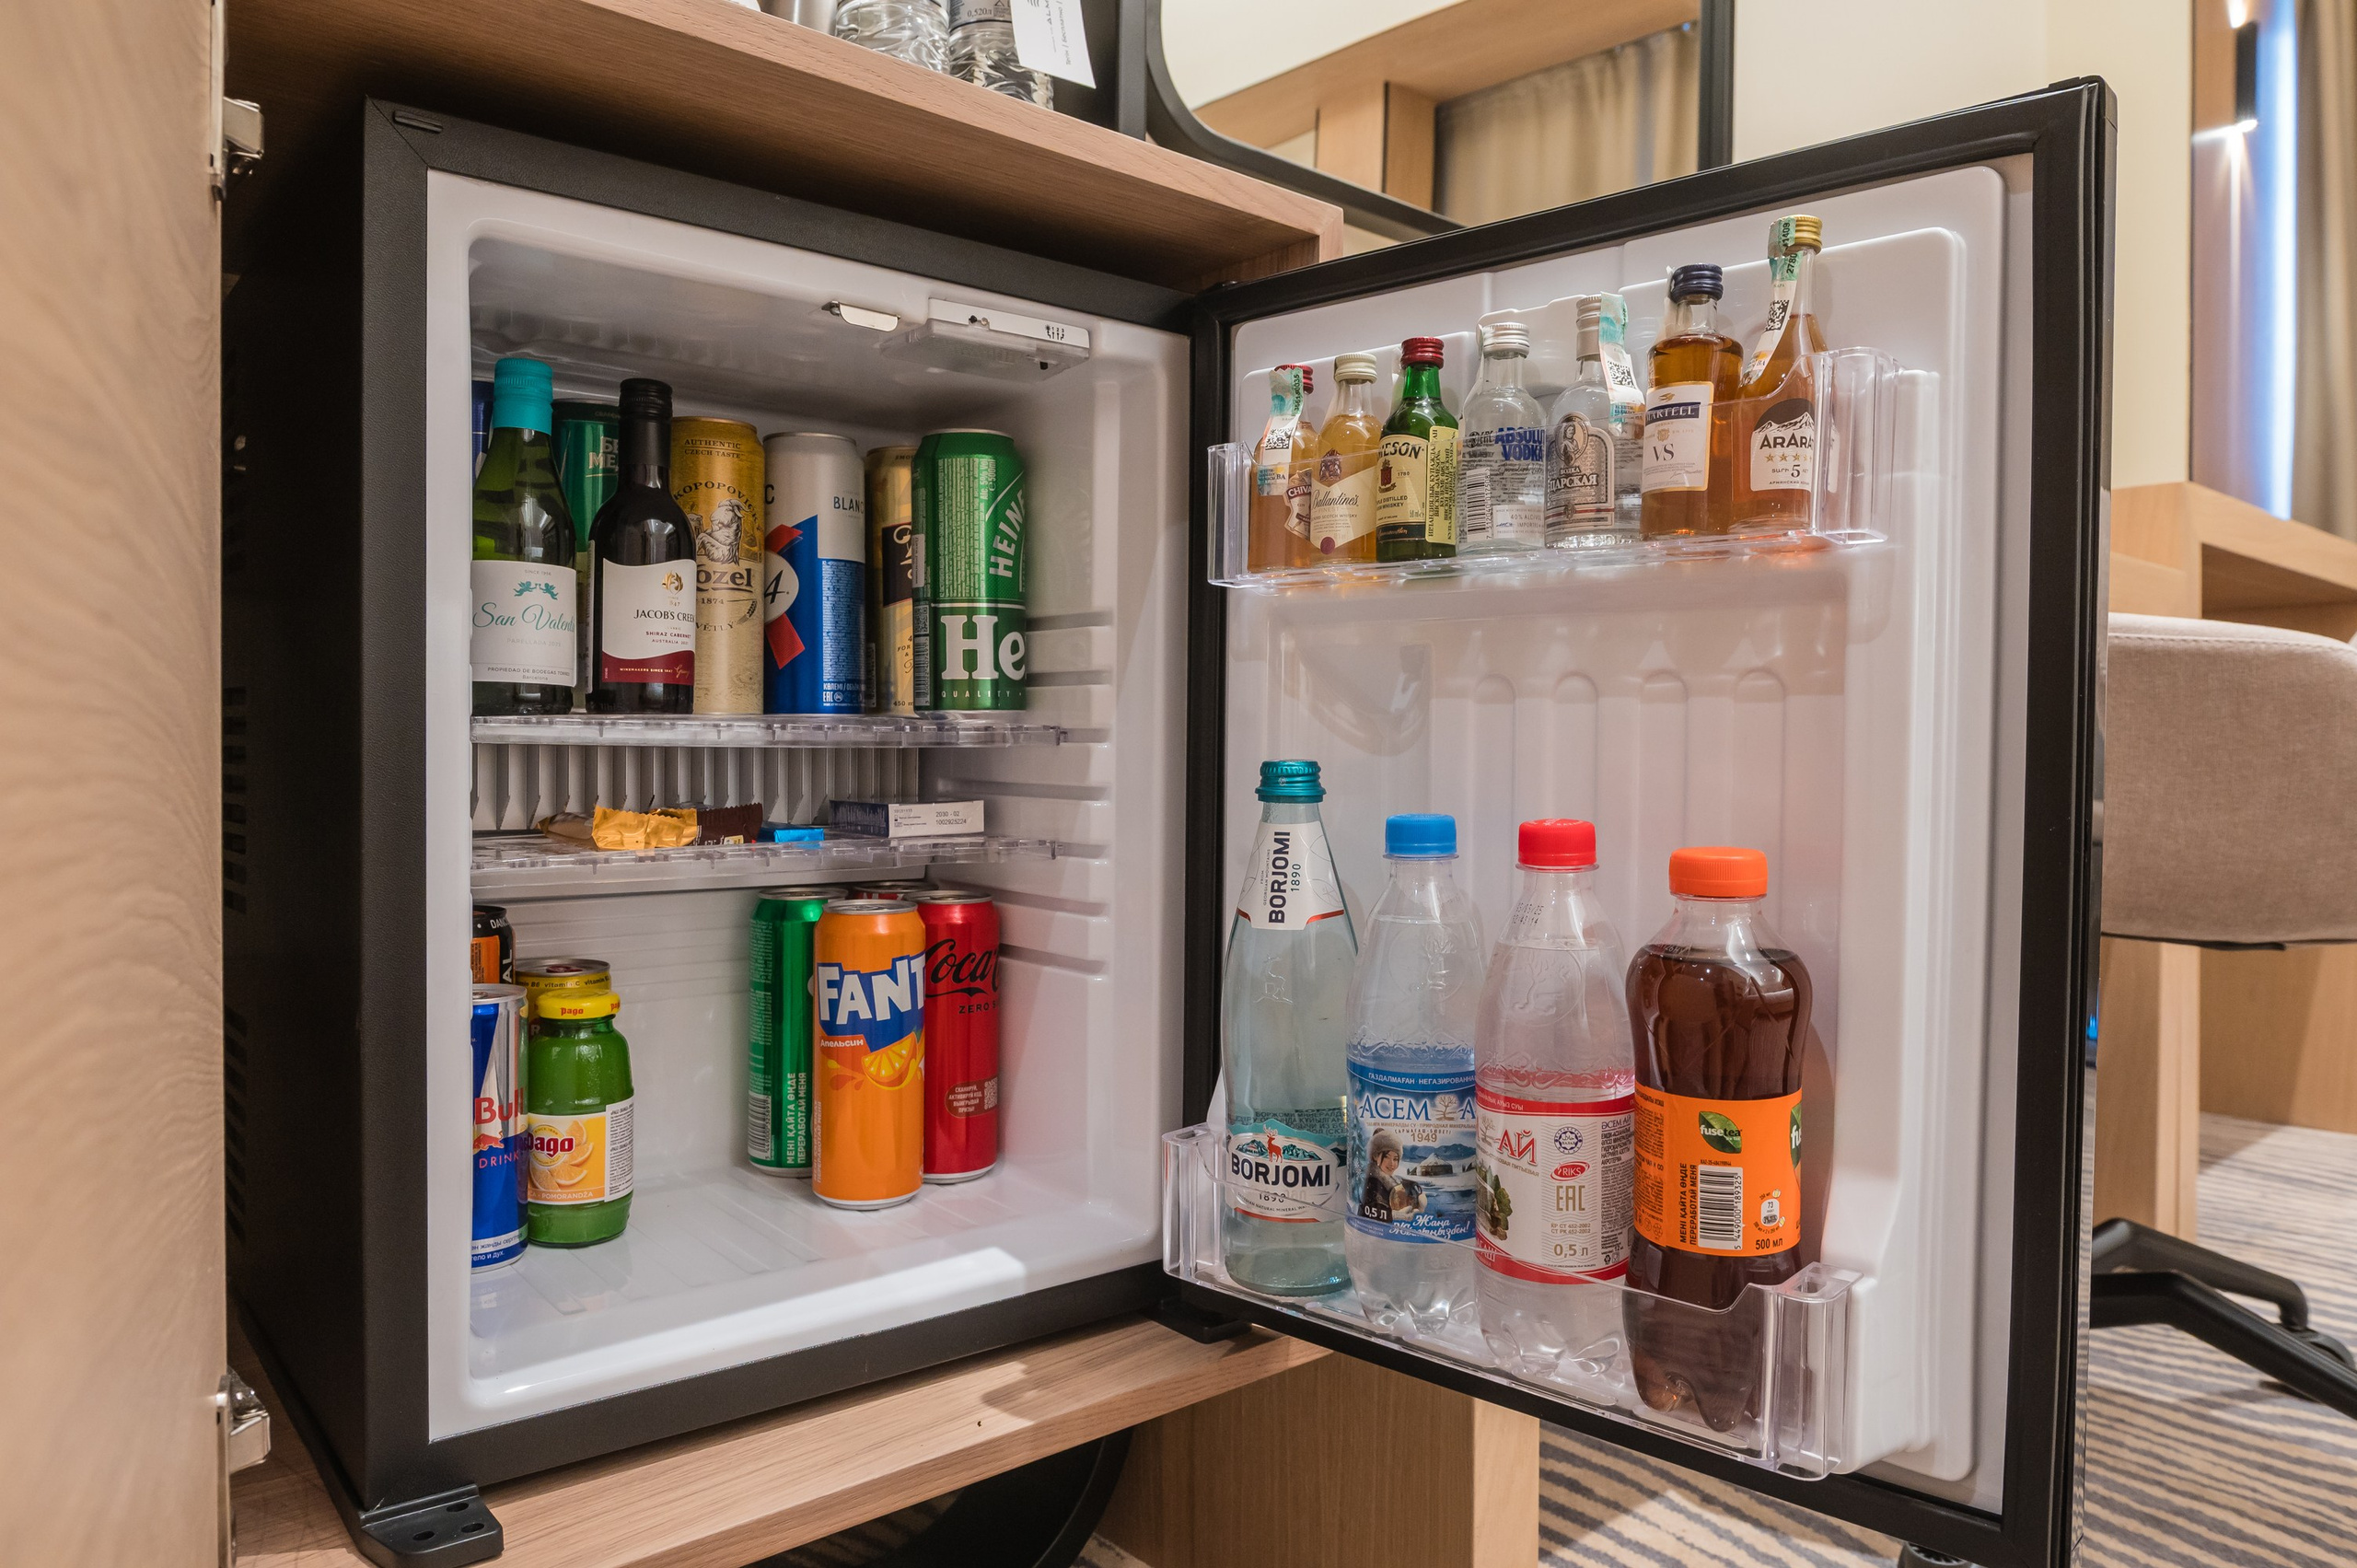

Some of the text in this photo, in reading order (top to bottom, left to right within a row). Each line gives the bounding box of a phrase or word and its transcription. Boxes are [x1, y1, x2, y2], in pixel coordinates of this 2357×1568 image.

[684, 439, 741, 449] AUTHENTIC
[1494, 427, 1545, 445] ABSOLU
[588, 452, 619, 471] МЕ
[1502, 444, 1544, 462] VODKA
[1653, 443, 1675, 462] VS
[1791, 464, 1800, 478] 5
[1288, 485, 1312, 498] CHIVA
[1549, 473, 1598, 493] ЦАРСКАЯ
[1313, 489, 1359, 509] Ballantine's
[472, 601, 517, 628] San
[633, 609, 675, 621] JACOB'S
[941, 614, 1026, 681] He
[941, 690, 1010, 698] QUALITY
[1268, 831, 1291, 923] BORJOMI
[1291, 864, 1302, 892] 1890
[584, 977, 605, 986] vitamin
[560, 1006, 585, 1016] pago
[958, 1002, 990, 1015] ZERO
[820, 1039, 865, 1048] Апельсин
[1368, 1072, 1476, 1086] ГАЗДАЛМАҒАН НЕГАЗИРОВАННА
[473, 1087, 524, 1125] Bull
[1511, 1102, 1524, 1111] СУЫ
[796, 1072, 807, 1164] ПЕРЕРАБОТАЙ МЕНЯ
[1411, 1132, 1438, 1143] 1949
[786, 1140, 795, 1164] МЕНІ
[1496, 1129, 1537, 1166] АЙ
[479, 1150, 519, 1169] DRINK
[1231, 1152, 1330, 1188] BORJOMI
[1679, 1162, 1688, 1189] ӨҢДЕ
[541, 1191, 594, 1200] POMORANDŽA
[1556, 1185, 1586, 1212] EAC
[1364, 1205, 1387, 1220] 0,5 Л
[1678, 1191, 1688, 1219] ҚАЙТА
[1767, 1201, 1774, 1209] 73
[1689, 1189, 1697, 1246] ПЕРЕРАБОТАЙ
[1553, 1244, 1577, 1259] 0,5
[1755, 1237, 1783, 1250] 500 мл
